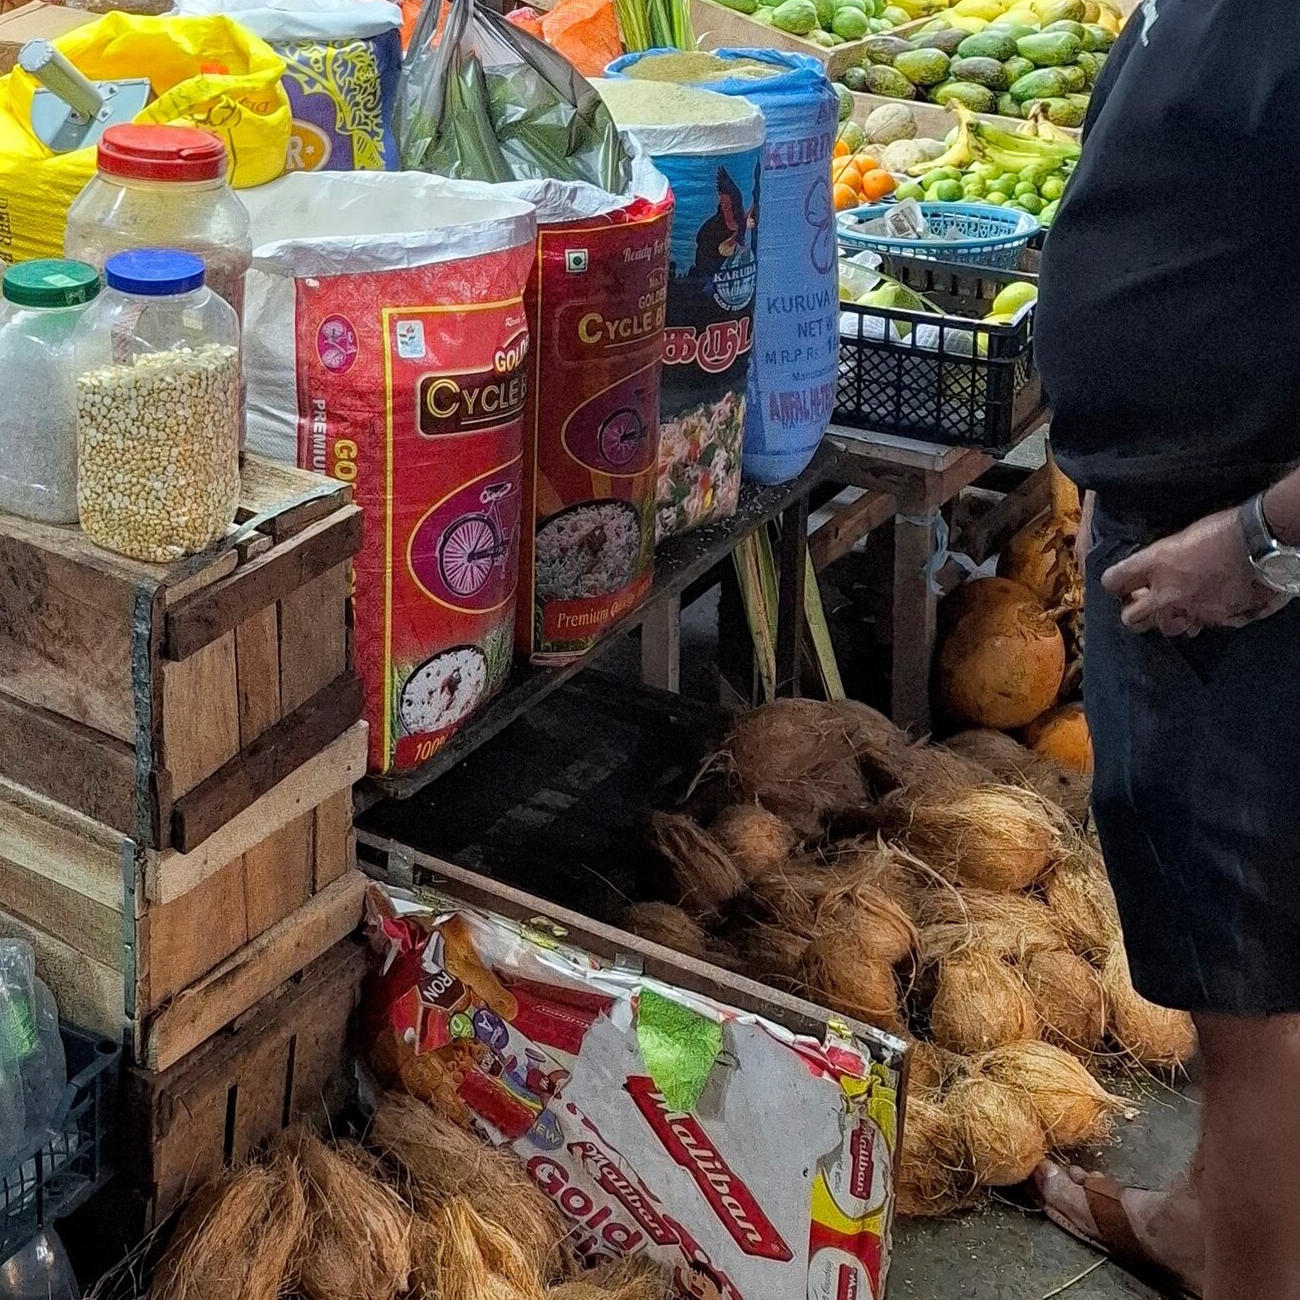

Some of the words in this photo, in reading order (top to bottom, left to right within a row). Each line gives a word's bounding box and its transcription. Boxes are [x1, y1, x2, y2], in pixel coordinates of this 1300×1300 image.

[638, 287, 667, 310] GOLDE
[767, 295, 831, 316] KURUVA
[578, 312, 651, 345] CYCLE
[797, 320, 824, 340] NET
[495, 332, 529, 373] GOLD
[426, 378, 519, 419] CYCLE
[557, 608, 609, 629] Premium
[528, 1155, 643, 1252] Gold
[584, 1141, 665, 1238] Maliban
